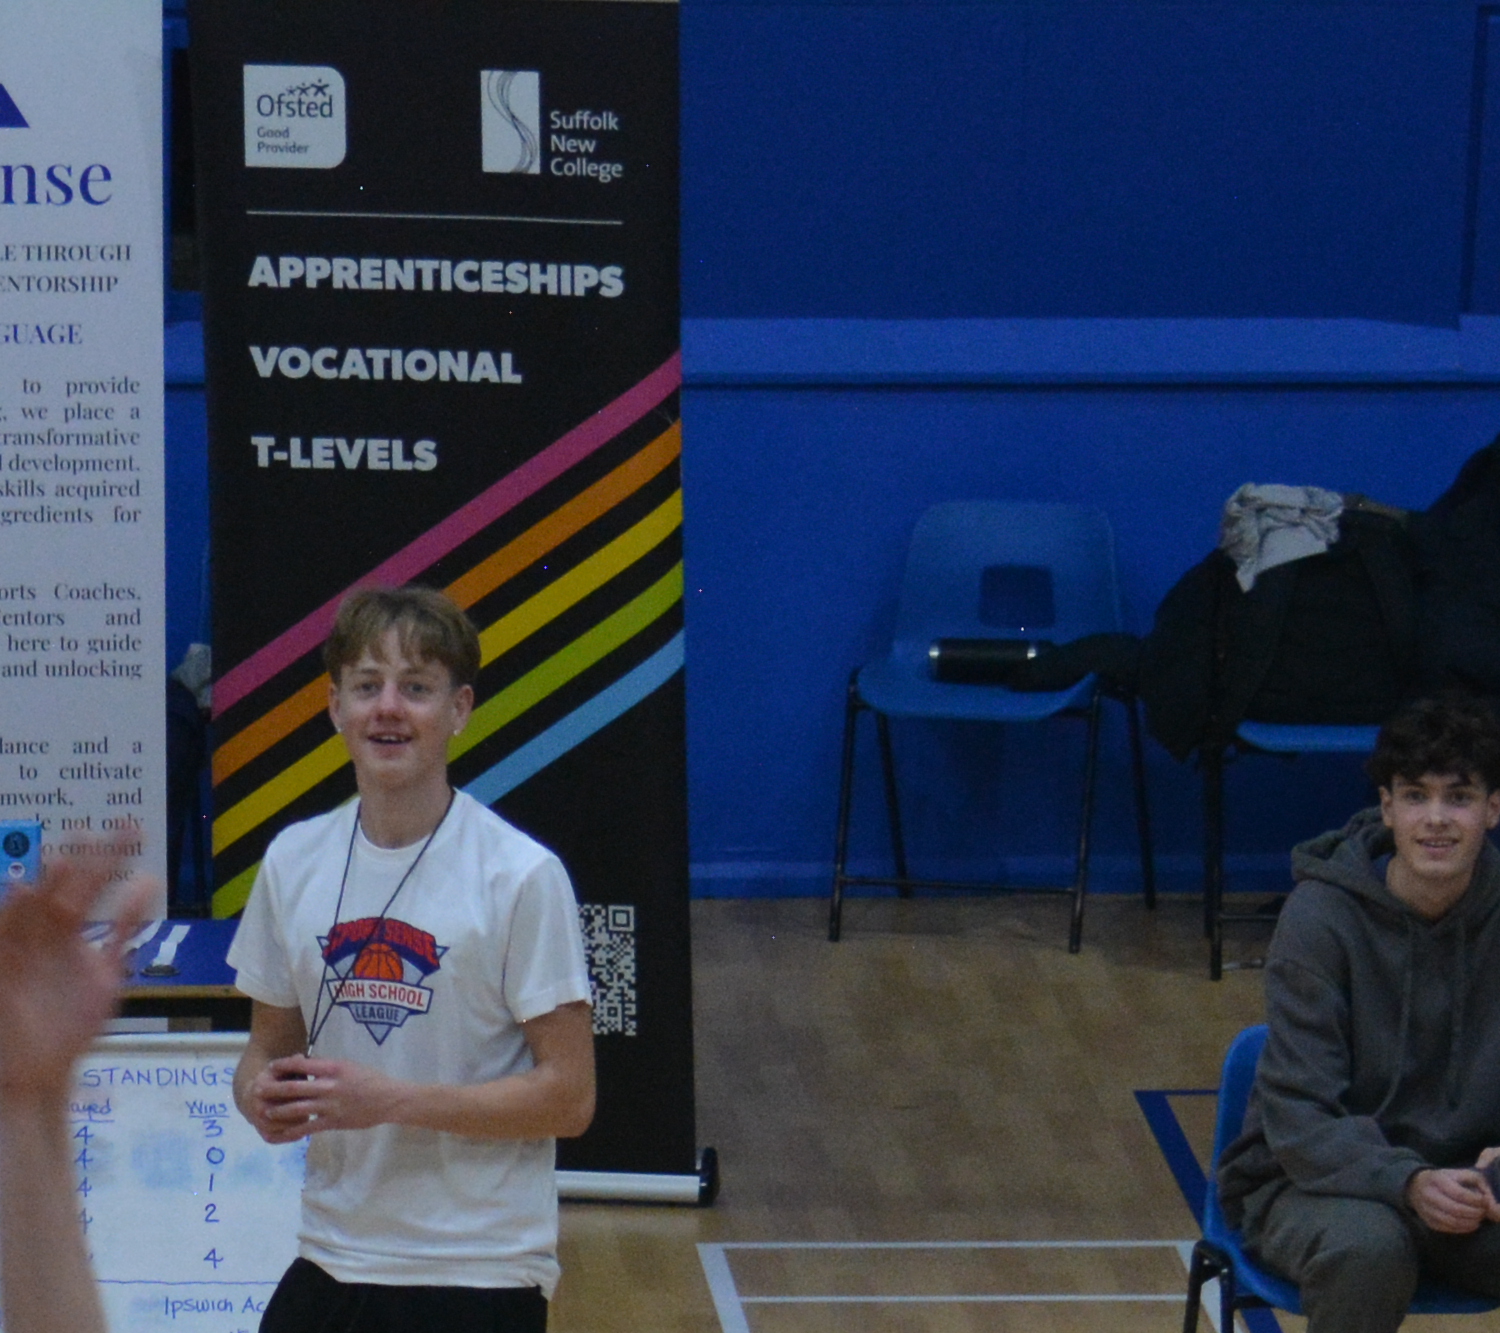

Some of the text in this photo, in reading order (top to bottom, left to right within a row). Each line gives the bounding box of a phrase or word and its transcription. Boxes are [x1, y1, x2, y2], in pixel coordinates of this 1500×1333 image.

[256, 92, 334, 119] Ofsted
[549, 109, 619, 131] Suffolk
[256, 125, 291, 140] Good
[550, 133, 597, 153] New
[256, 140, 309, 154] Provider
[549, 156, 624, 184] College
[21, 243, 133, 262] THROUGH
[248, 255, 624, 298] APPRENTICESHIPS
[249, 346, 523, 384] VOCATIONAL
[22, 378, 43, 394] to
[65, 375, 141, 398] provide
[20, 407, 48, 420] we
[63, 401, 115, 424] place
[129, 406, 141, 420] a
[251, 436, 438, 471] T-LEVELS
[54, 478, 141, 502] acquired
[113, 505, 142, 524] for
[333, 983, 425, 1008] HIGH SCHOOL
[354, 1003, 400, 1022] LEAGUE
[185, 1100, 229, 1116] Wins
[74, 1126, 94, 1145] 4
[202, 1119, 224, 1138] 3
[74, 1148, 94, 1170] 4
[206, 1146, 226, 1165] 0
[204, 1203, 221, 1223] 2
[203, 1248, 225, 1270] 4
[164, 1295, 234, 1317] Ipswich
